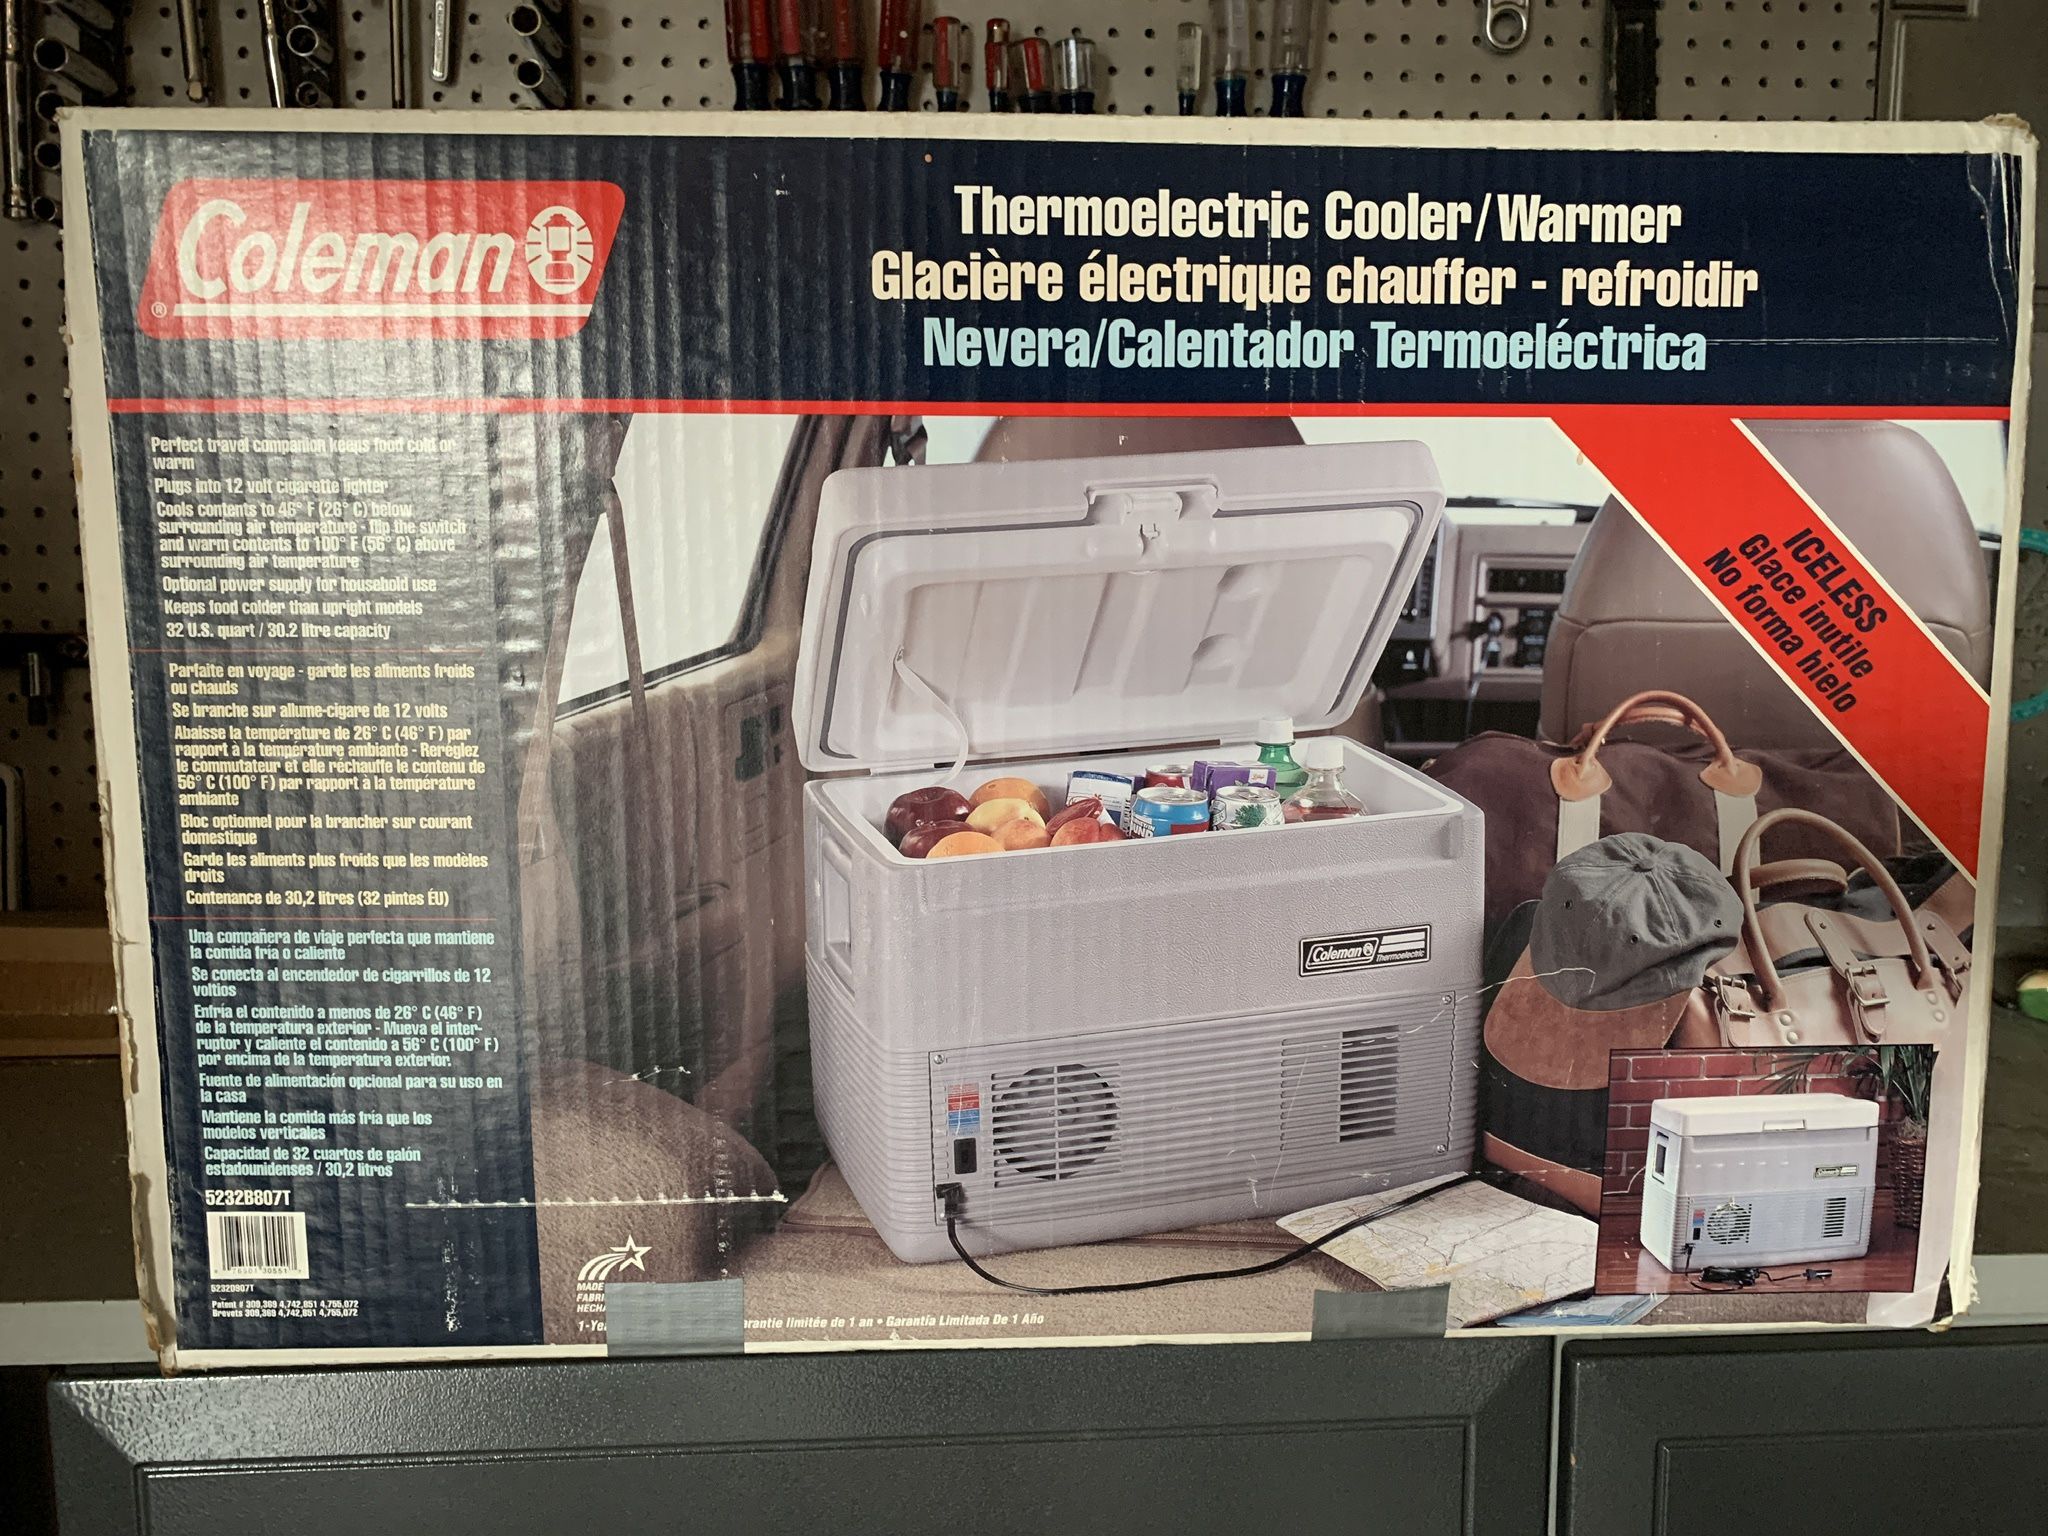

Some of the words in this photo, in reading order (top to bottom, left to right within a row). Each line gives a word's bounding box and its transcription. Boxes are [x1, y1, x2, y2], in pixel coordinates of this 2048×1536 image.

[954, 185, 1309, 238] Thermoelectric
[1325, 190, 1682, 243] Cooler/Warmer
[178, 199, 514, 298] Coleman
[871, 248, 1063, 301] Glacière
[1079, 249, 1311, 311] électrique
[1326, 256, 1516, 305] chauffer
[1531, 279, 1547, 290] -
[1561, 260, 1758, 307] refroidir
[923, 317, 1354, 369] Nevera/Calentador
[1370, 318, 1707, 370] Termoeléctrica
[152, 458, 196, 470] warm
[154, 479, 192, 496] Plugs
[195, 479, 223, 493] into
[226, 479, 243, 493] 12
[245, 479, 272, 493] volt
[276, 479, 338, 496] cigarette
[162, 577, 216, 594] Optional
[219, 579, 265, 594] power
[268, 577, 312, 594] supply
[315, 577, 336, 592] for
[340, 577, 408, 592] household
[411, 580, 436, 592] use
[1782, 528, 1887, 632] ICELESS
[164, 600, 205, 617] Keeps
[208, 600, 238, 614] food
[241, 600, 286, 614] colder
[289, 600, 319, 615] than
[322, 601, 371, 618] upright
[375, 601, 422, 615] models
[1739, 534, 1806, 605] Glace
[1799, 600, 1873, 679] inutile
[166, 623, 184, 637] 32
[187, 623, 214, 637] U.S.
[216, 623, 255, 640] quart
[258, 623, 263, 637] /
[267, 623, 298, 637] 30.2
[301, 623, 331, 637] litre
[334, 623, 390, 640] capacity
[1703, 547, 1742, 586] No
[1735, 584, 1804, 656] forma
[1796, 649, 1857, 713] hielo
[169, 664, 224, 677] Parfaite
[227, 667, 244, 677] en
[247, 667, 295, 680] voyage
[307, 665, 347, 680] garde
[350, 665, 370, 678] les
[374, 665, 430, 678] aliments
[434, 665, 474, 678] froids
[171, 683, 187, 694] ou
[189, 681, 238, 694] chauds
[172, 704, 189, 717] Se
[192, 704, 248, 717] branche
[252, 707, 276, 717] sur
[279, 704, 370, 720] allume-cigare
[373, 704, 390, 718] de
[393, 705, 411, 718] 12
[414, 705, 447, 718] volts
[180, 815, 208, 828] Bloc
[212, 815, 272, 831] optionnel
[275, 818, 306, 831] pour
[309, 815, 322, 828] la
[325, 815, 388, 828] brancher
[391, 818, 416, 828] sur
[419, 815, 472, 828] courant
[183, 853, 223, 866] Garde
[226, 853, 246, 866] les
[249, 853, 305, 866] aliments
[308, 853, 336, 869] plus
[339, 853, 379, 866] froids
[382, 856, 406, 869] que
[409, 854, 430, 866] les
[433, 852, 488, 867] modèles
[184, 869, 224, 882] droits
[185, 892, 262, 904] Contenance
[265, 892, 281, 905] de
[284, 892, 314, 907] 30,2
[318, 892, 354, 905] litres
[357, 892, 380, 907] (32
[383, 892, 424, 908] pintes
[427, 889, 449, 905] ÉU)
[188, 930, 214, 943] Una
[216, 930, 290, 946] compañera
[293, 930, 310, 944] de
[313, 930, 344, 946] viaje
[347, 931, 404, 947] perfecta
[406, 933, 431, 947] que
[434, 931, 494, 944] mantiene
[190, 946, 202, 959] la
[204, 946, 252, 959] comida
[254, 944, 279, 959] fría
[282, 948, 291, 959] o
[294, 946, 345, 959] caliente
[1313, 946, 1361, 962] Coleman
[1376, 950, 1425, 962] Thermoelectric
[191, 968, 208, 980] Se
[211, 968, 264, 980] conecta
[266, 968, 278, 981] al
[281, 968, 359, 981] encendedor
[362, 968, 379, 981] de
[381, 969, 450, 984] cigarrillos
[453, 969, 470, 982] de
[473, 969, 491, 982] 12
[193, 984, 236, 996] voltios
[201, 1111, 261, 1124] Mantiene
[264, 1111, 276, 1124] la
[279, 1111, 325, 1124] comida
[328, 1111, 355, 1124] más
[358, 1110, 383, 1124] fría
[386, 1114, 409, 1127] que
[412, 1112, 432, 1124] los
[203, 1127, 256, 1139] modelos
[259, 1127, 325, 1139] verticales
[204, 1147, 270, 1162] Capacidad
[272, 1148, 289, 1160] de
[292, 1148, 309, 1160] 32
[313, 1148, 364, 1160] cuartos
[366, 1148, 383, 1160] de
[386, 1145, 421, 1163] galón
[205, 1163, 313, 1175] estadounidenses
[316, 1164, 321, 1176] /
[325, 1164, 354, 1178] 30,2
[357, 1164, 392, 1176] litros
[205, 1189, 291, 1206] 5232B807T
[576, 1282, 605, 1291] MADE
[744, 1317, 784, 1329] arantie
[786, 1316, 828, 1328] limitée
[830, 1316, 845, 1327] de
[849, 1316, 855, 1327] 1
[858, 1318, 874, 1327] an
[886, 1314, 936, 1327] Garantía
[938, 1314, 990, 1326] Limitada
[993, 1313, 1008, 1324] De
[1012, 1313, 1018, 1324] 1
[1021, 1312, 1045, 1325] Año
